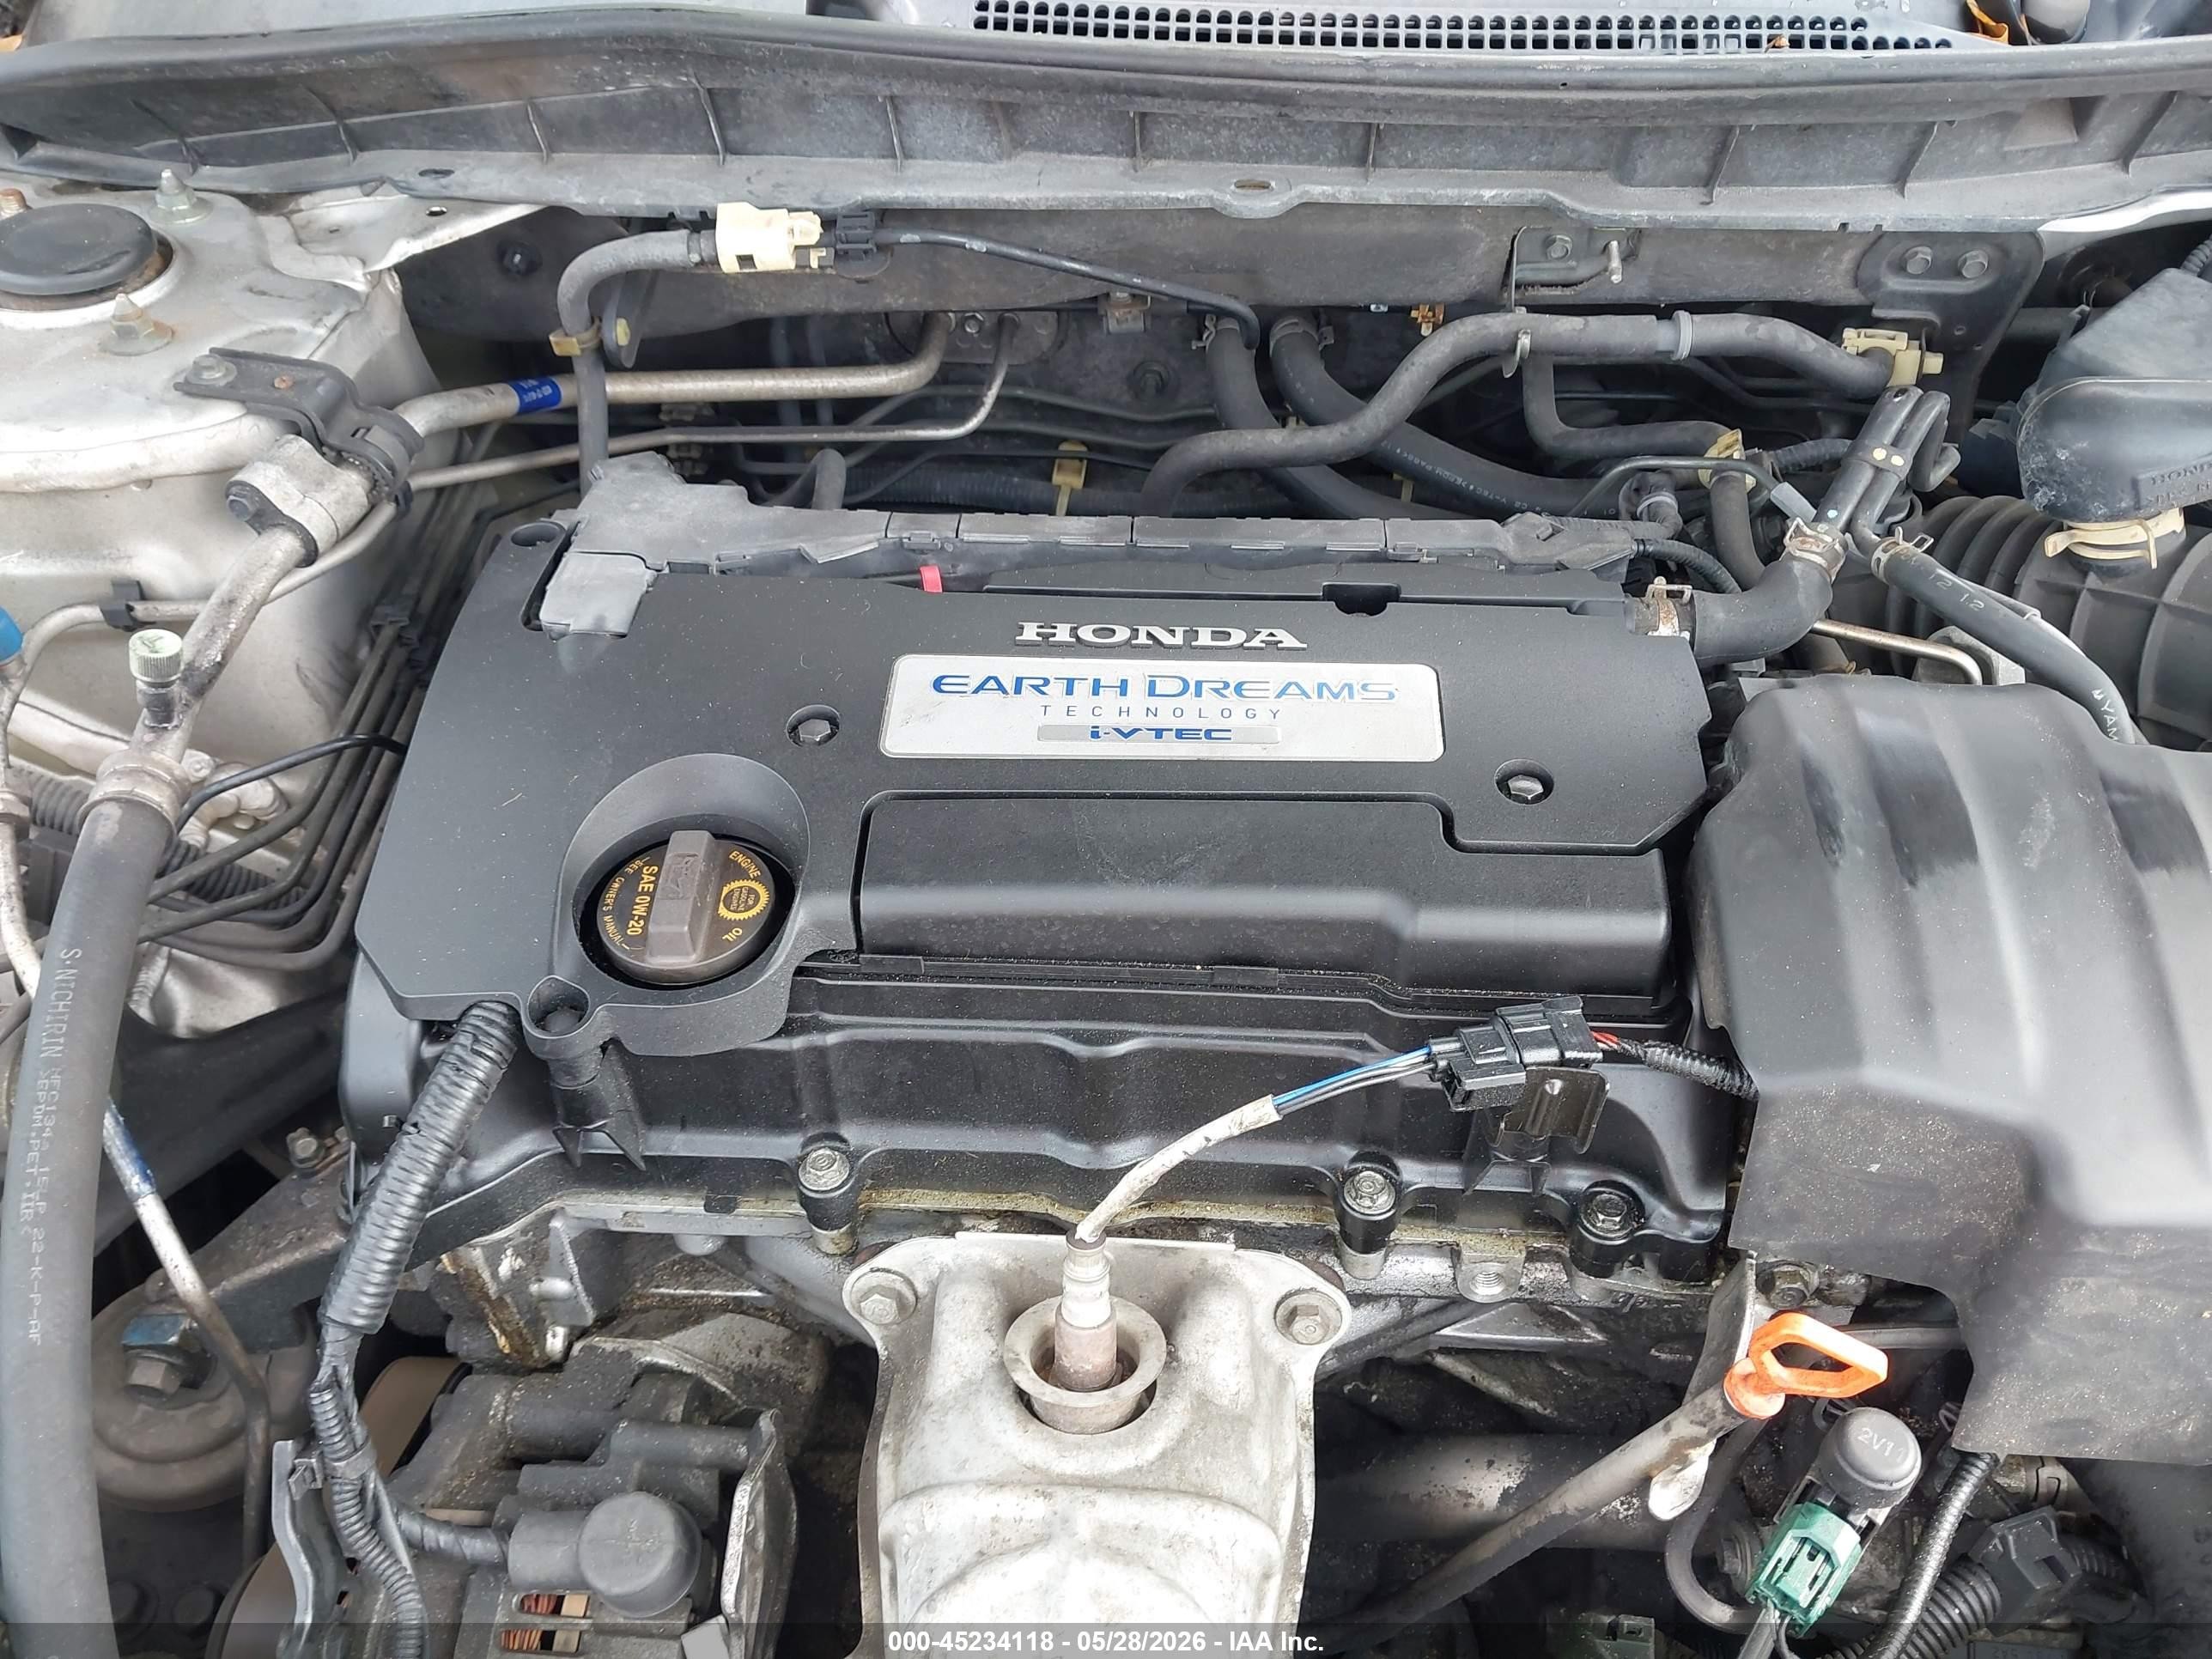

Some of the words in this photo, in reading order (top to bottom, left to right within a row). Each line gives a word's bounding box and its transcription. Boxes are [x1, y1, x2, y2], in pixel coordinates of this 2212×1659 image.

[1015, 622, 1308, 651] HONDA
[932, 673, 1129, 697] EARTH
[1146, 674, 1396, 701] DREAMS
[1040, 704, 1280, 720] TECHNOLOGY
[1090, 725, 1232, 741] i-VTEC
[729, 850, 761, 879] ENGINE
[638, 865, 659, 892] SAE
[721, 927, 743, 943] OIL
